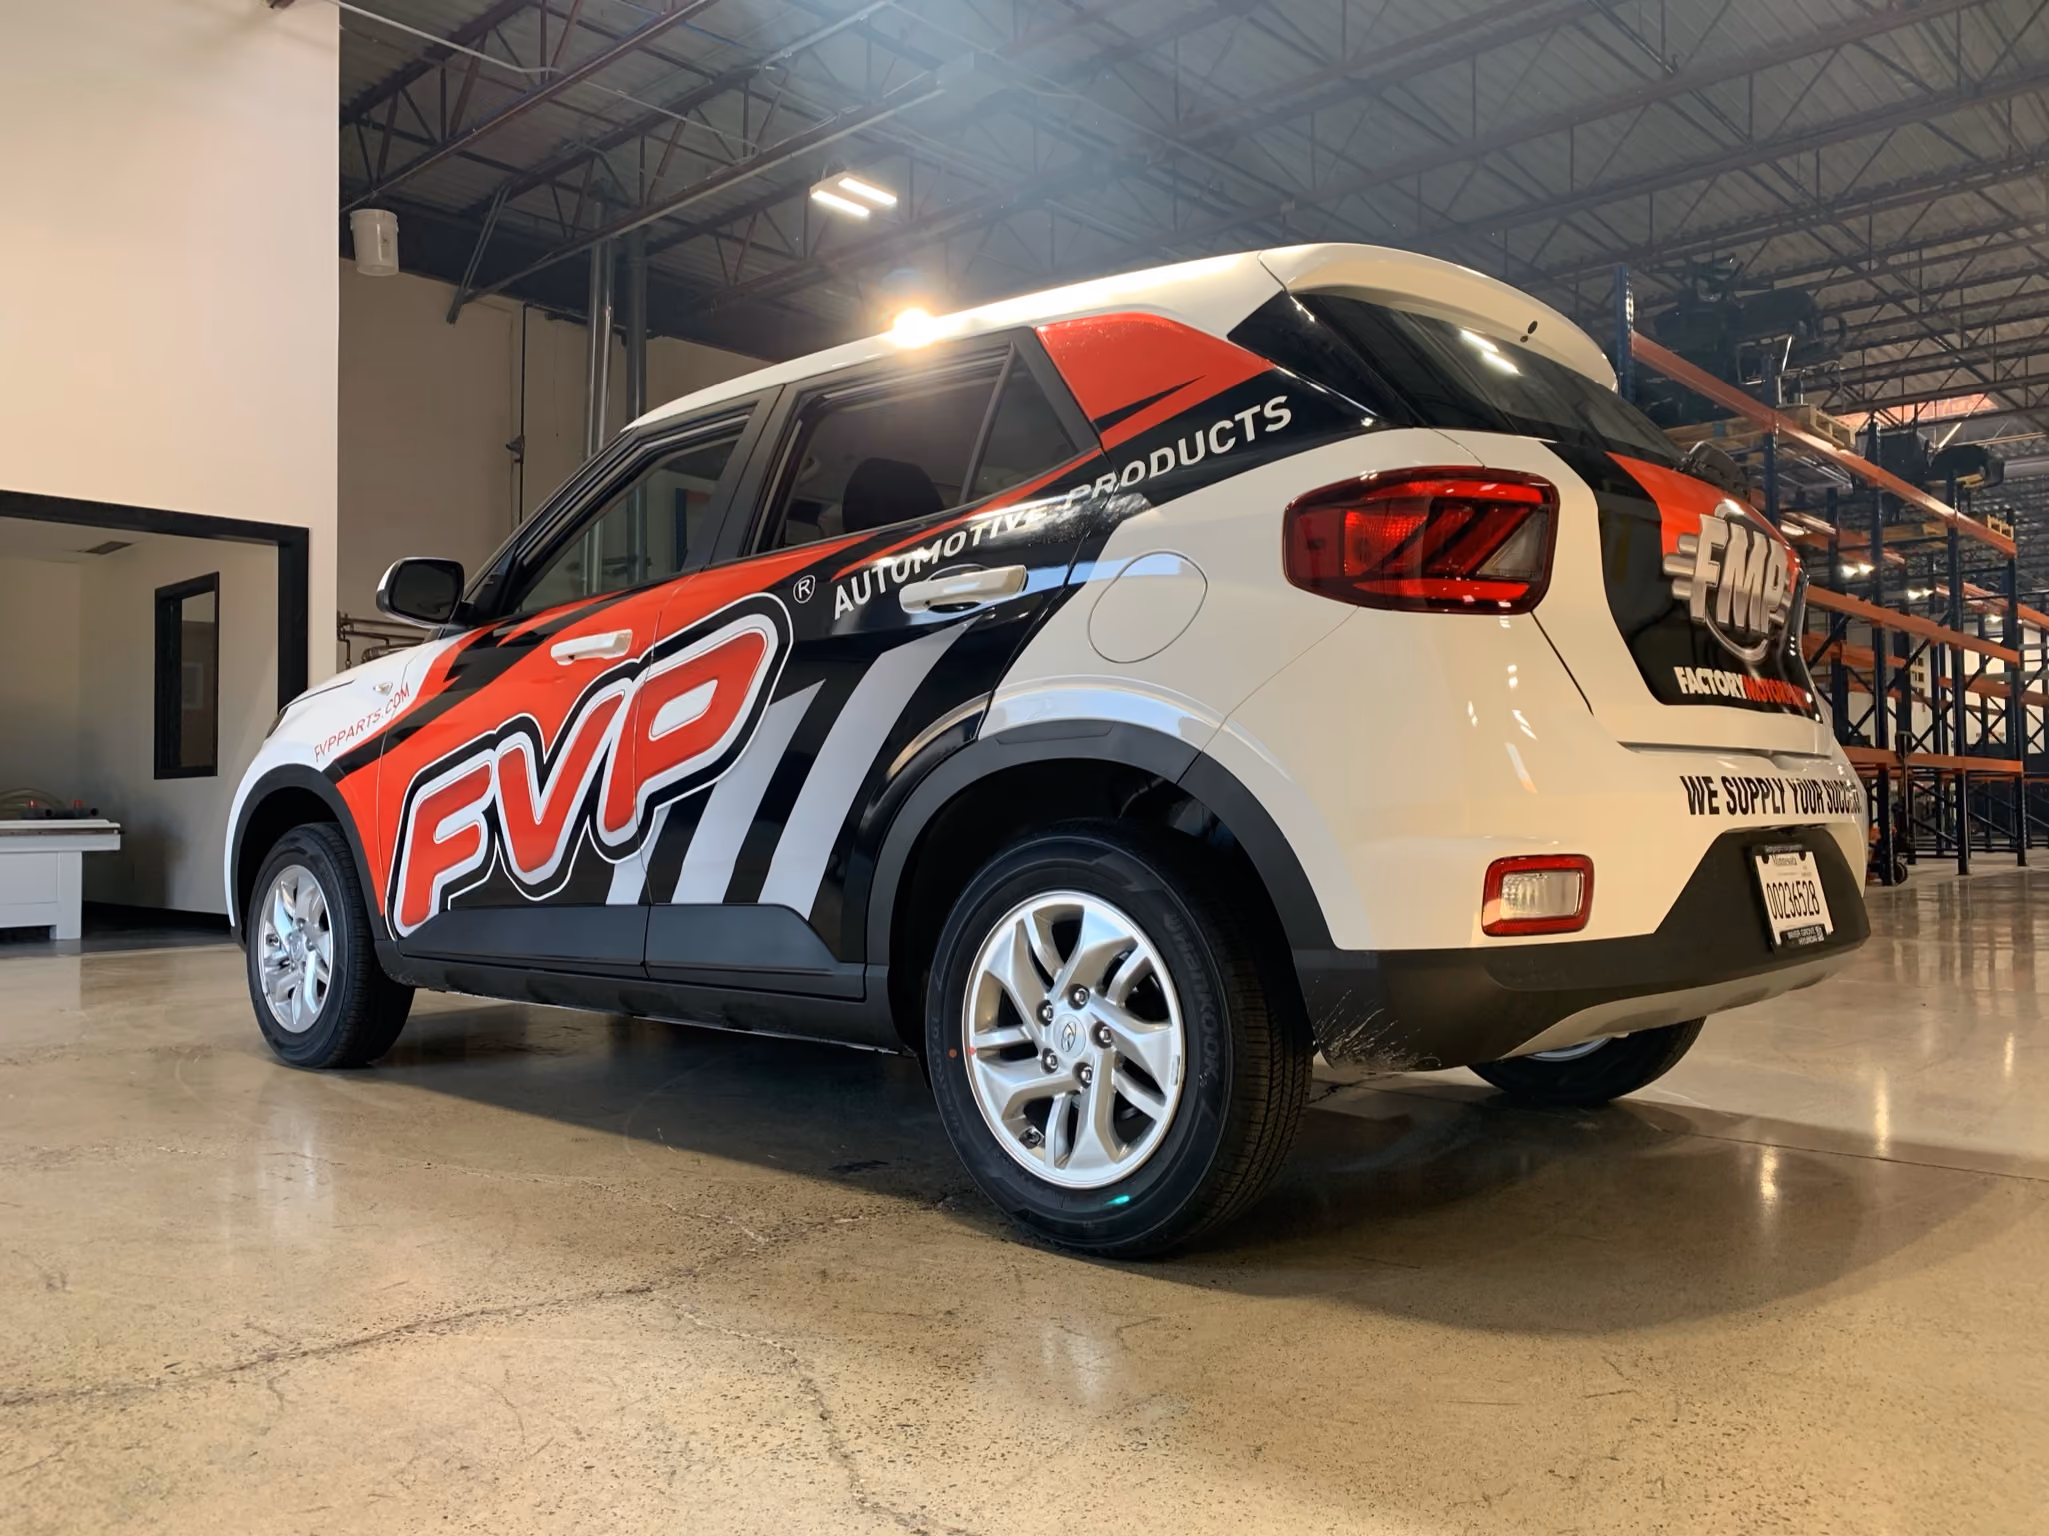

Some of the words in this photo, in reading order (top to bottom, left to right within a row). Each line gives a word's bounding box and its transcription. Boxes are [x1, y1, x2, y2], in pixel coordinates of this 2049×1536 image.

[834, 504, 1048, 621] AUTOMOTIVE
[1063, 395, 1293, 510] PRODUCTS
[1690, 513, 1789, 635] FMP
[313, 681, 411, 763] FVPPARTS.COM
[393, 612, 780, 938] FVP
[1679, 775, 1720, 815] WE
[1720, 775, 1786, 815] SUPPLY
[1785, 777, 1825, 815] YOUR
[1766, 879, 1821, 920] 00236528
